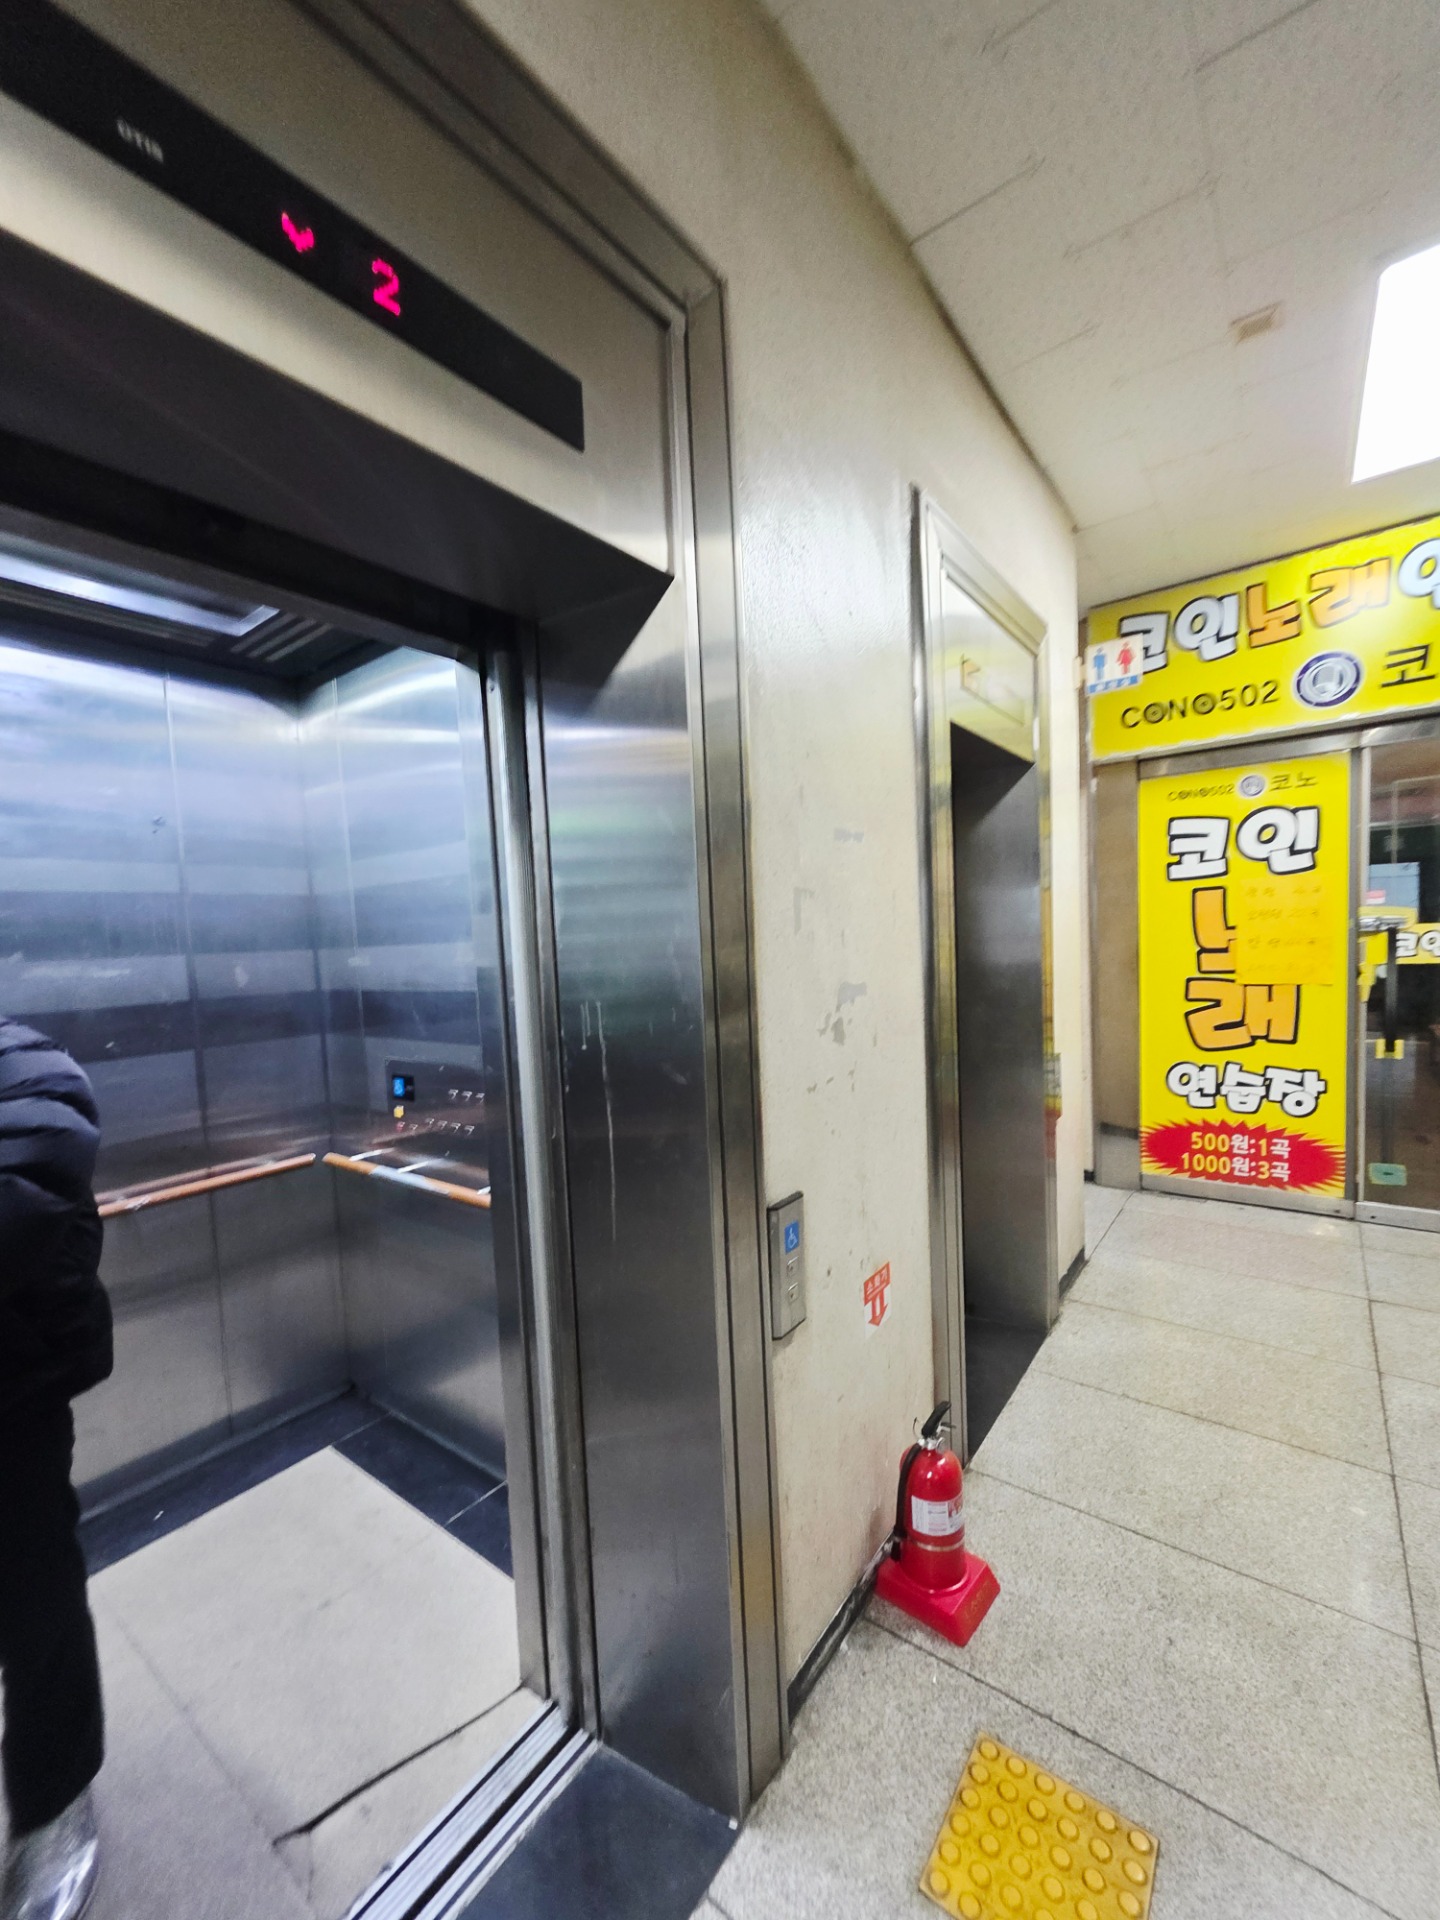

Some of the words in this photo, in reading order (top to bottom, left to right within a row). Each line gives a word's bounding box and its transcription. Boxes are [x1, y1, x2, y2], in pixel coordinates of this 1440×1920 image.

[372, 257, 402, 316] 2
[1269, 772, 1319, 792] 코노
[1166, 806, 1320, 882] 코인
[1166, 1061, 1328, 1118] 연습장
